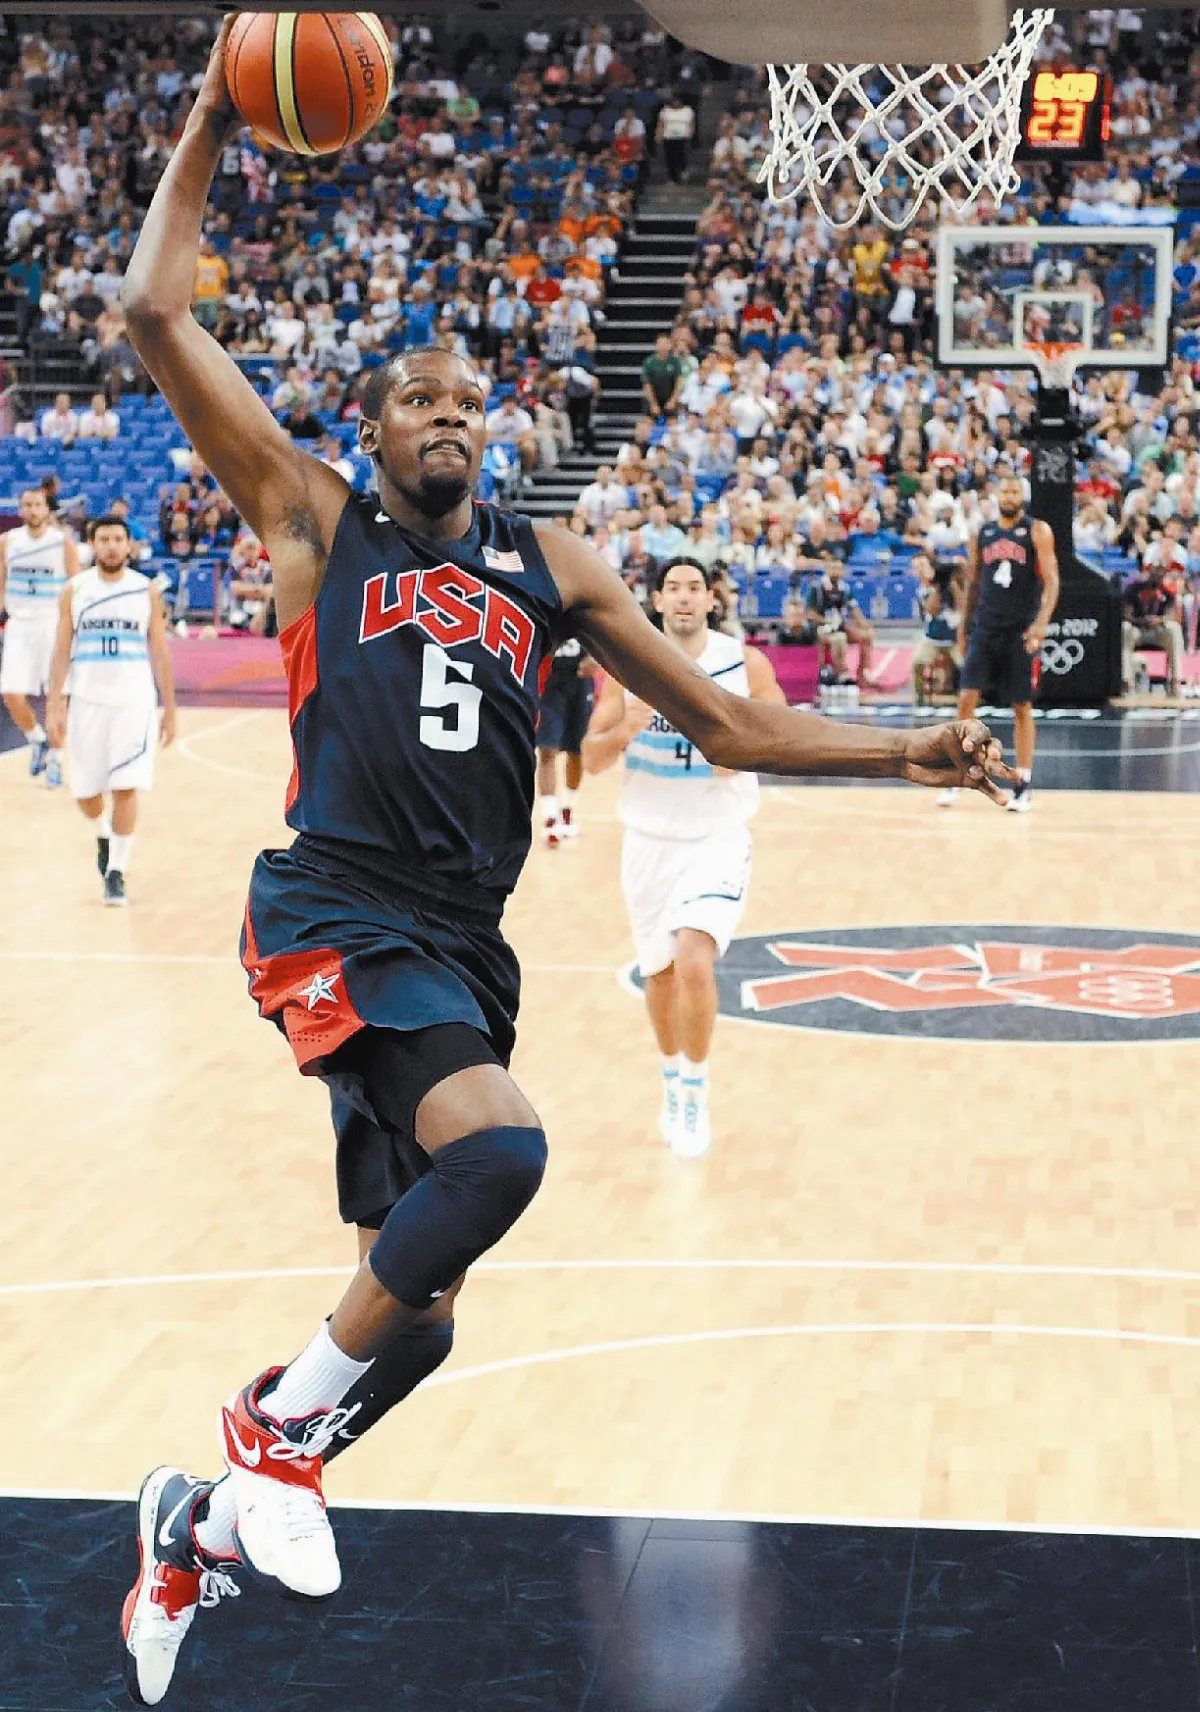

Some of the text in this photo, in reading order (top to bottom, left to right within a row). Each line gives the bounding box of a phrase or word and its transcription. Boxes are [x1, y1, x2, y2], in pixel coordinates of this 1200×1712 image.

[1028, 102, 1084, 141] 23
[993, 560, 1013, 588] 4
[358, 562, 536, 688] USA
[101, 635, 118, 657] 10
[419, 643, 484, 752] 5
[675, 740, 692, 771] 4
